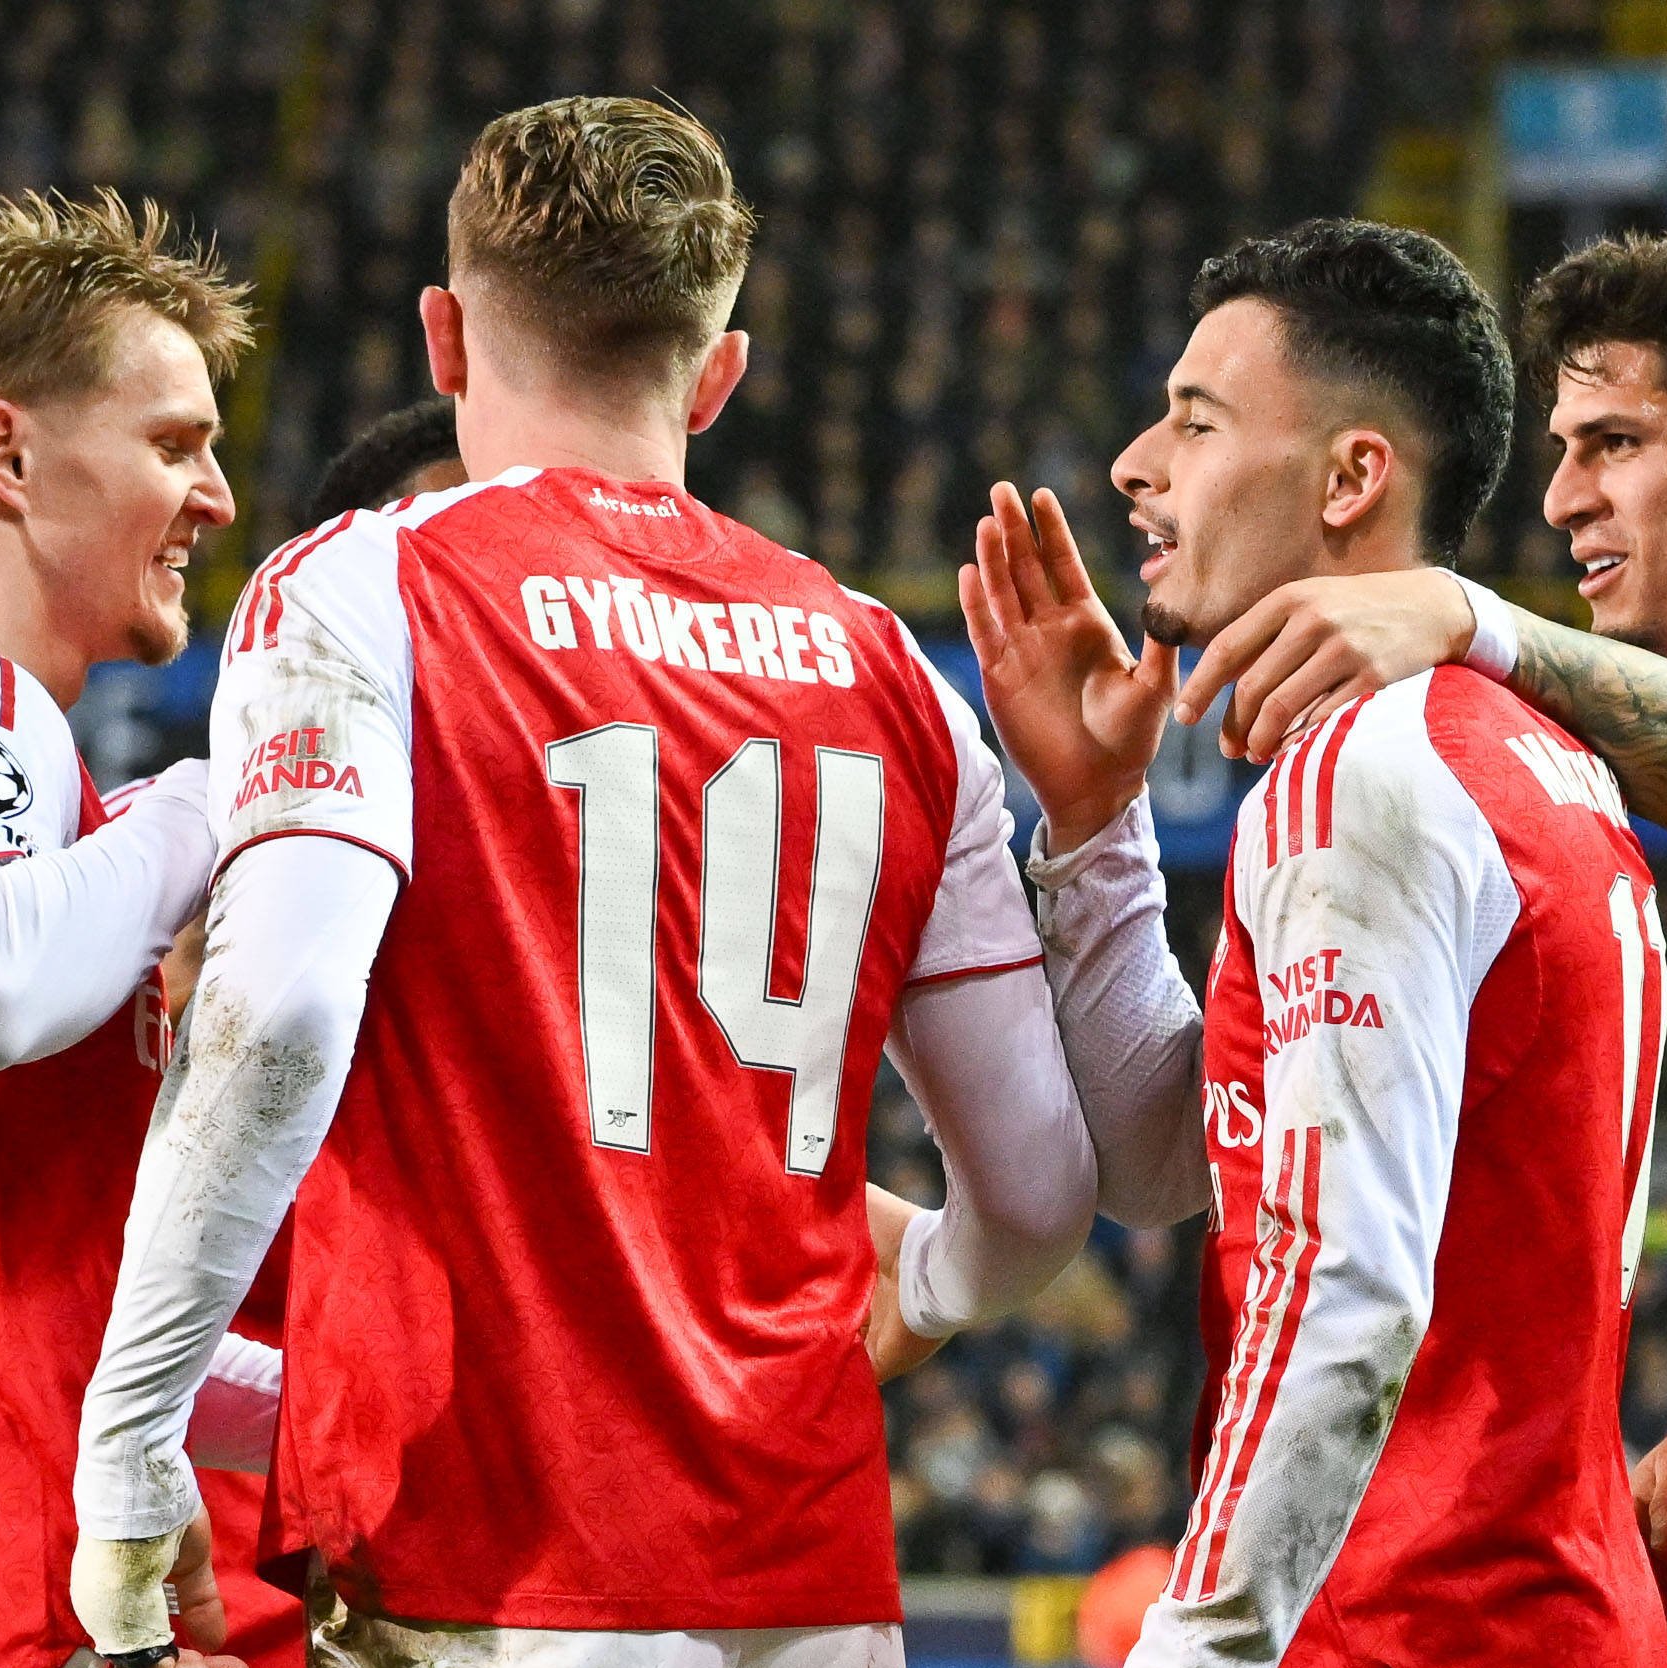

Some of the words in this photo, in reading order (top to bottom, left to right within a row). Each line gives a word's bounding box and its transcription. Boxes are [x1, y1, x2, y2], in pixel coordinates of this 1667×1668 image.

[588, 487, 682, 518] Arsenal
[242, 727, 325, 779] VISIT
[229, 760, 364, 822] WANDA
[545, 722, 884, 1177] 14
[1267, 948, 1342, 1003] VIST
